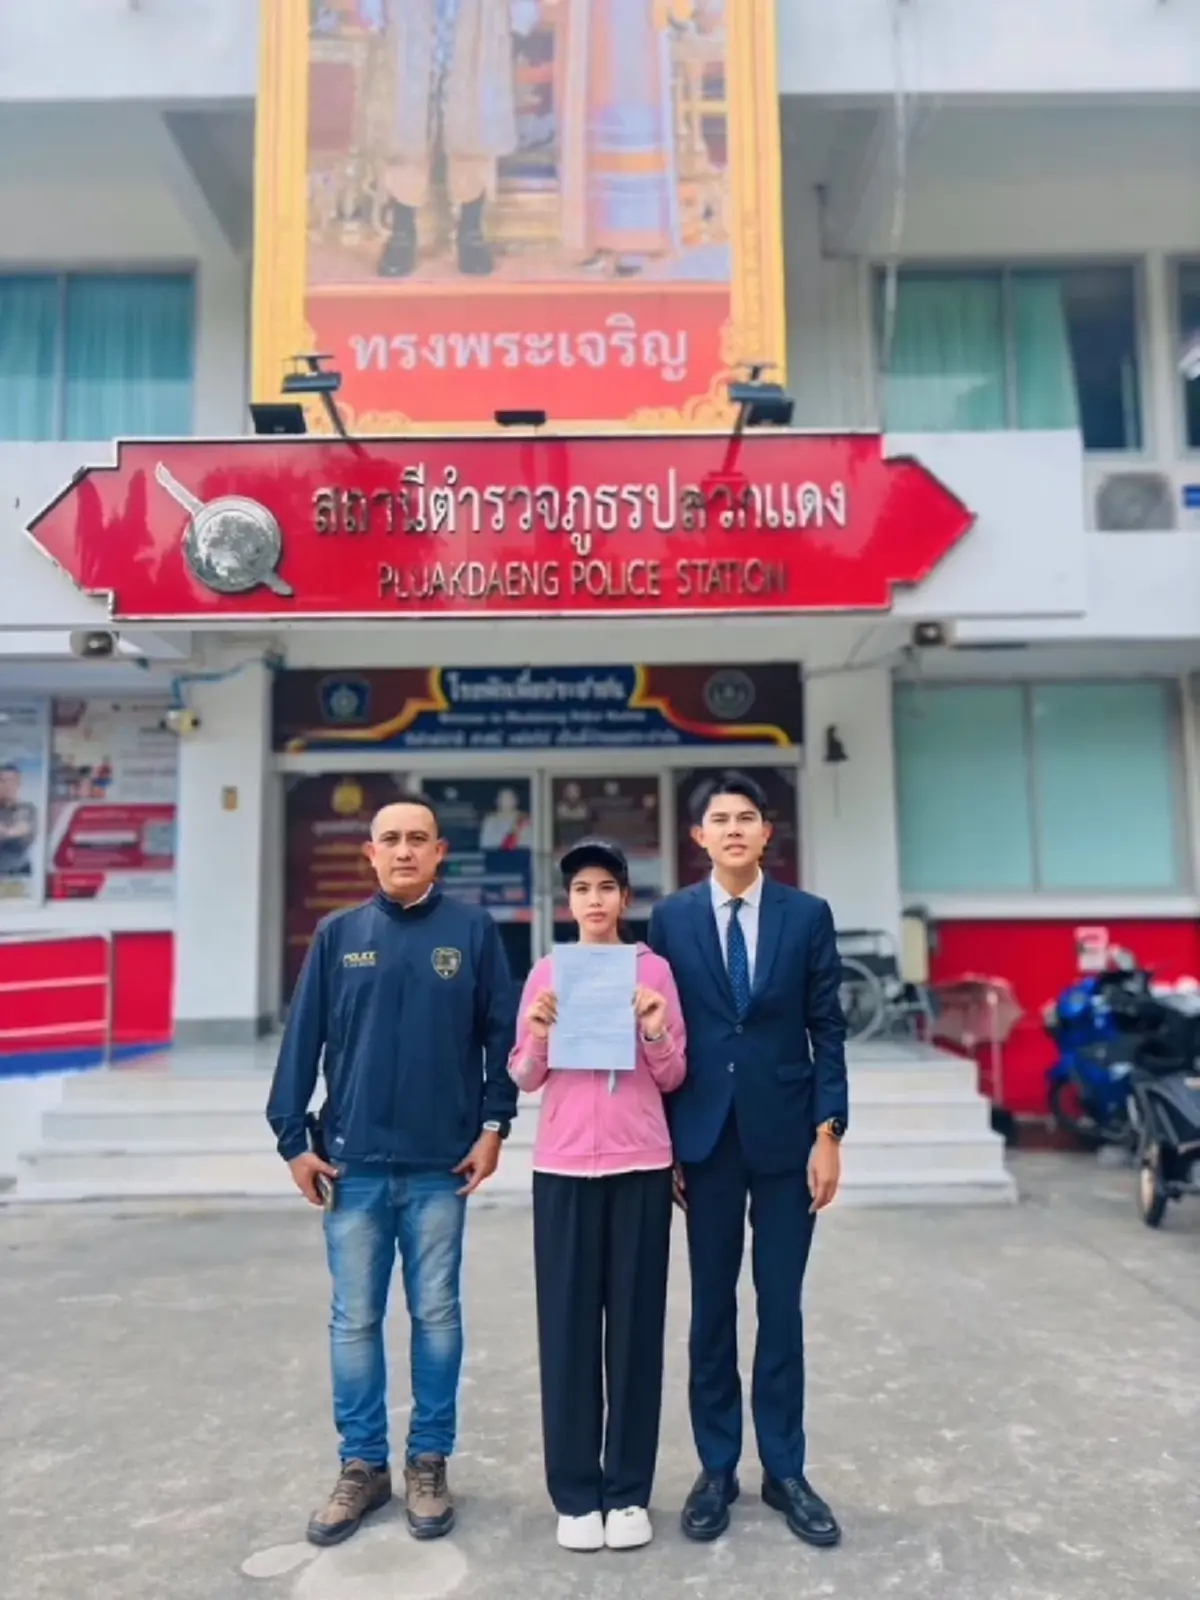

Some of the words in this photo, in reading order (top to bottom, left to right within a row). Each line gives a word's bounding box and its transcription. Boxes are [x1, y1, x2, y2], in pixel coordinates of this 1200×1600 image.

[348, 312, 688, 382] ทรงพระเจริญ
[312, 462, 847, 557] สถานีตำรวจภูธรปลวกแดง
[571, 559, 661, 597] POLICE
[676, 557, 788, 596] STATION
